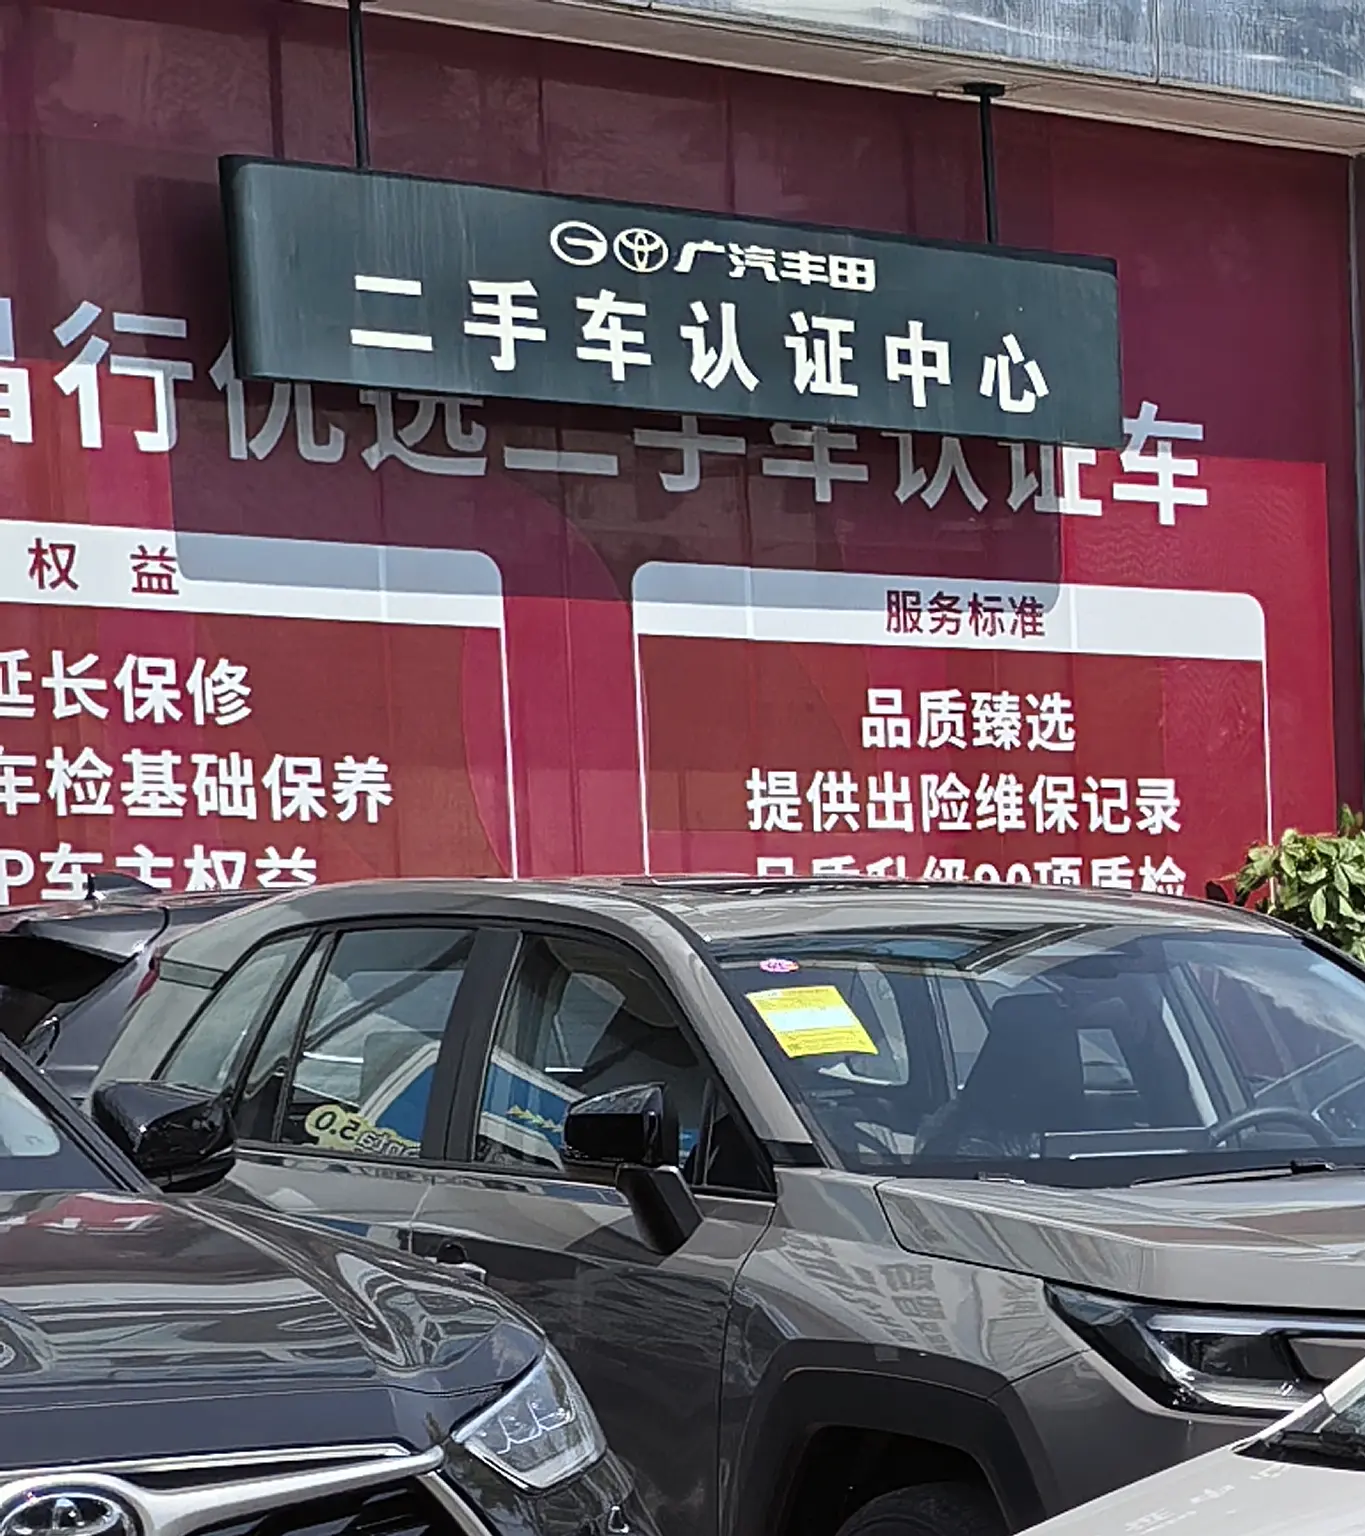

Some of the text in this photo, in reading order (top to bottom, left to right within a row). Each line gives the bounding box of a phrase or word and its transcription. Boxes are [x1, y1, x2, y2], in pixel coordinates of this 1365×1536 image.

[674, 239, 876, 292] 广汽丰田
[350, 274, 1050, 413] 二手车认证中心
[28, 537, 180, 595] 权益
[885, 588, 1047, 638] 服务标准
[861, 689, 1077, 753] 品质臻选
[745, 768, 1182, 835] 提供出险维保记录
